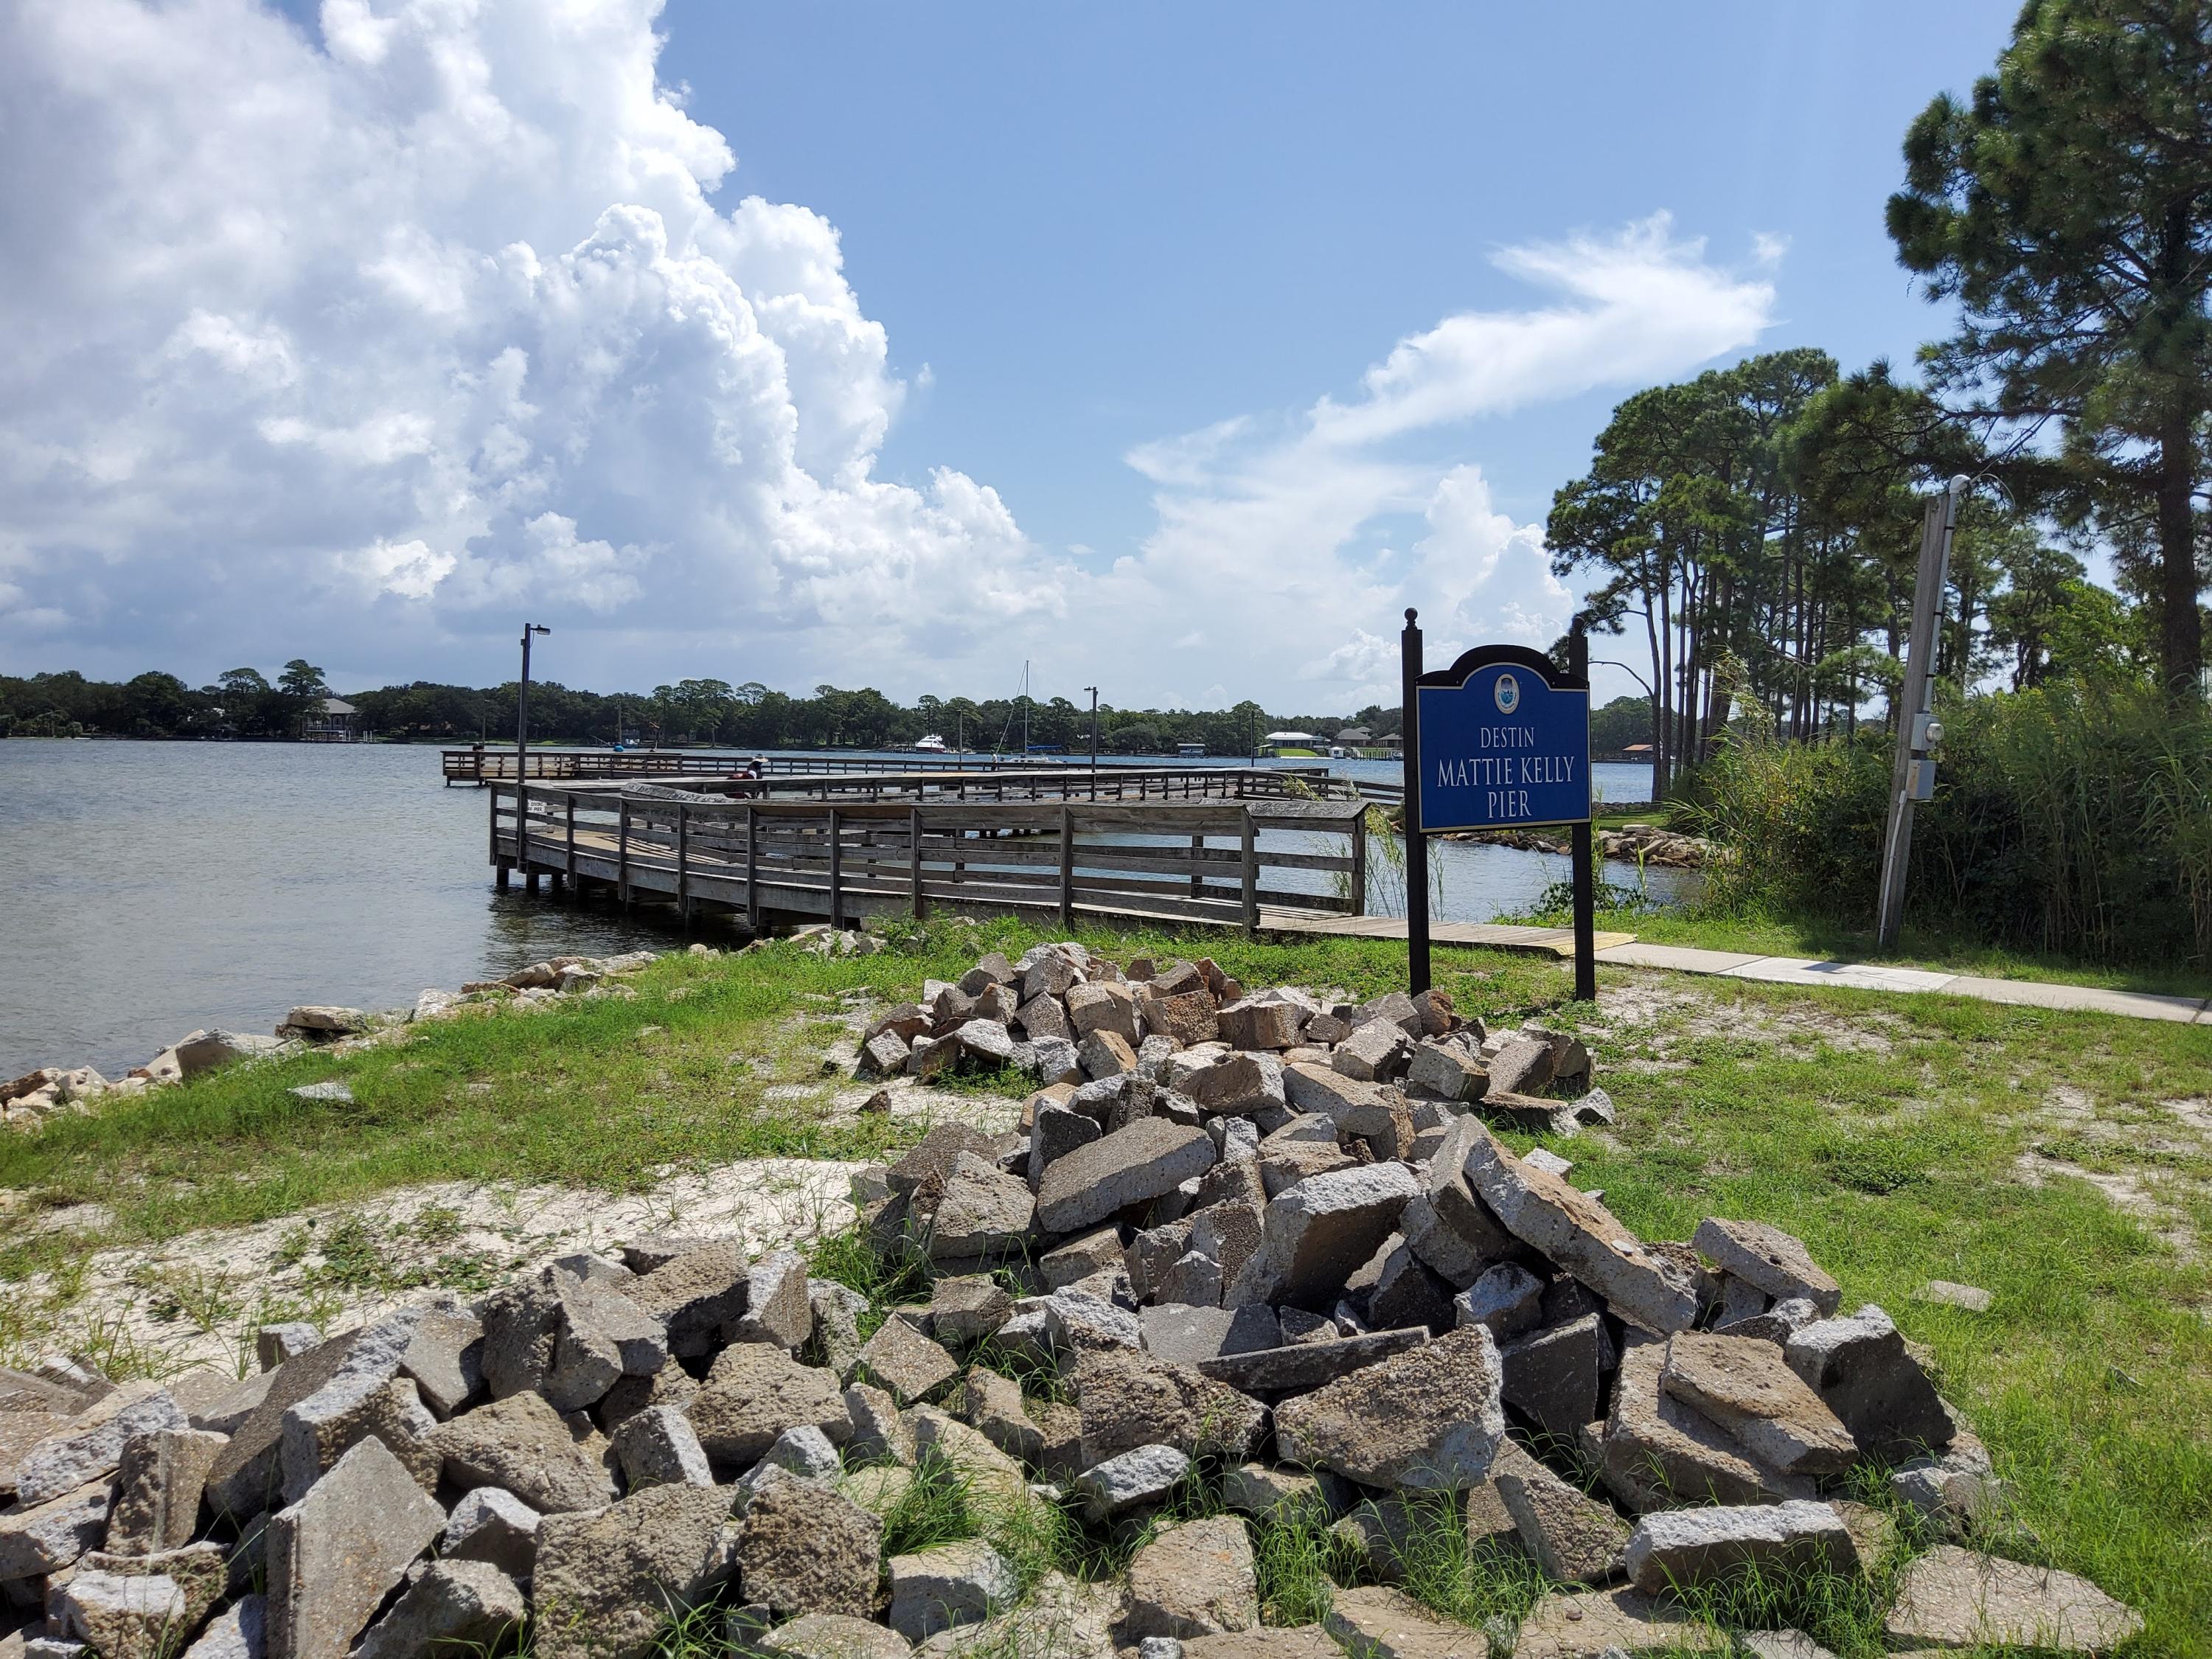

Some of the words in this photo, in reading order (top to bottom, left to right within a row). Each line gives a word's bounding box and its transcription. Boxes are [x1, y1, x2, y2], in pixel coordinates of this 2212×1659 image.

[1481, 727, 1534, 748] DESTIN
[1437, 757, 1513, 787] MATTIE
[1520, 756, 1575, 784] KELLY
[1488, 790, 1531, 818] PIER
